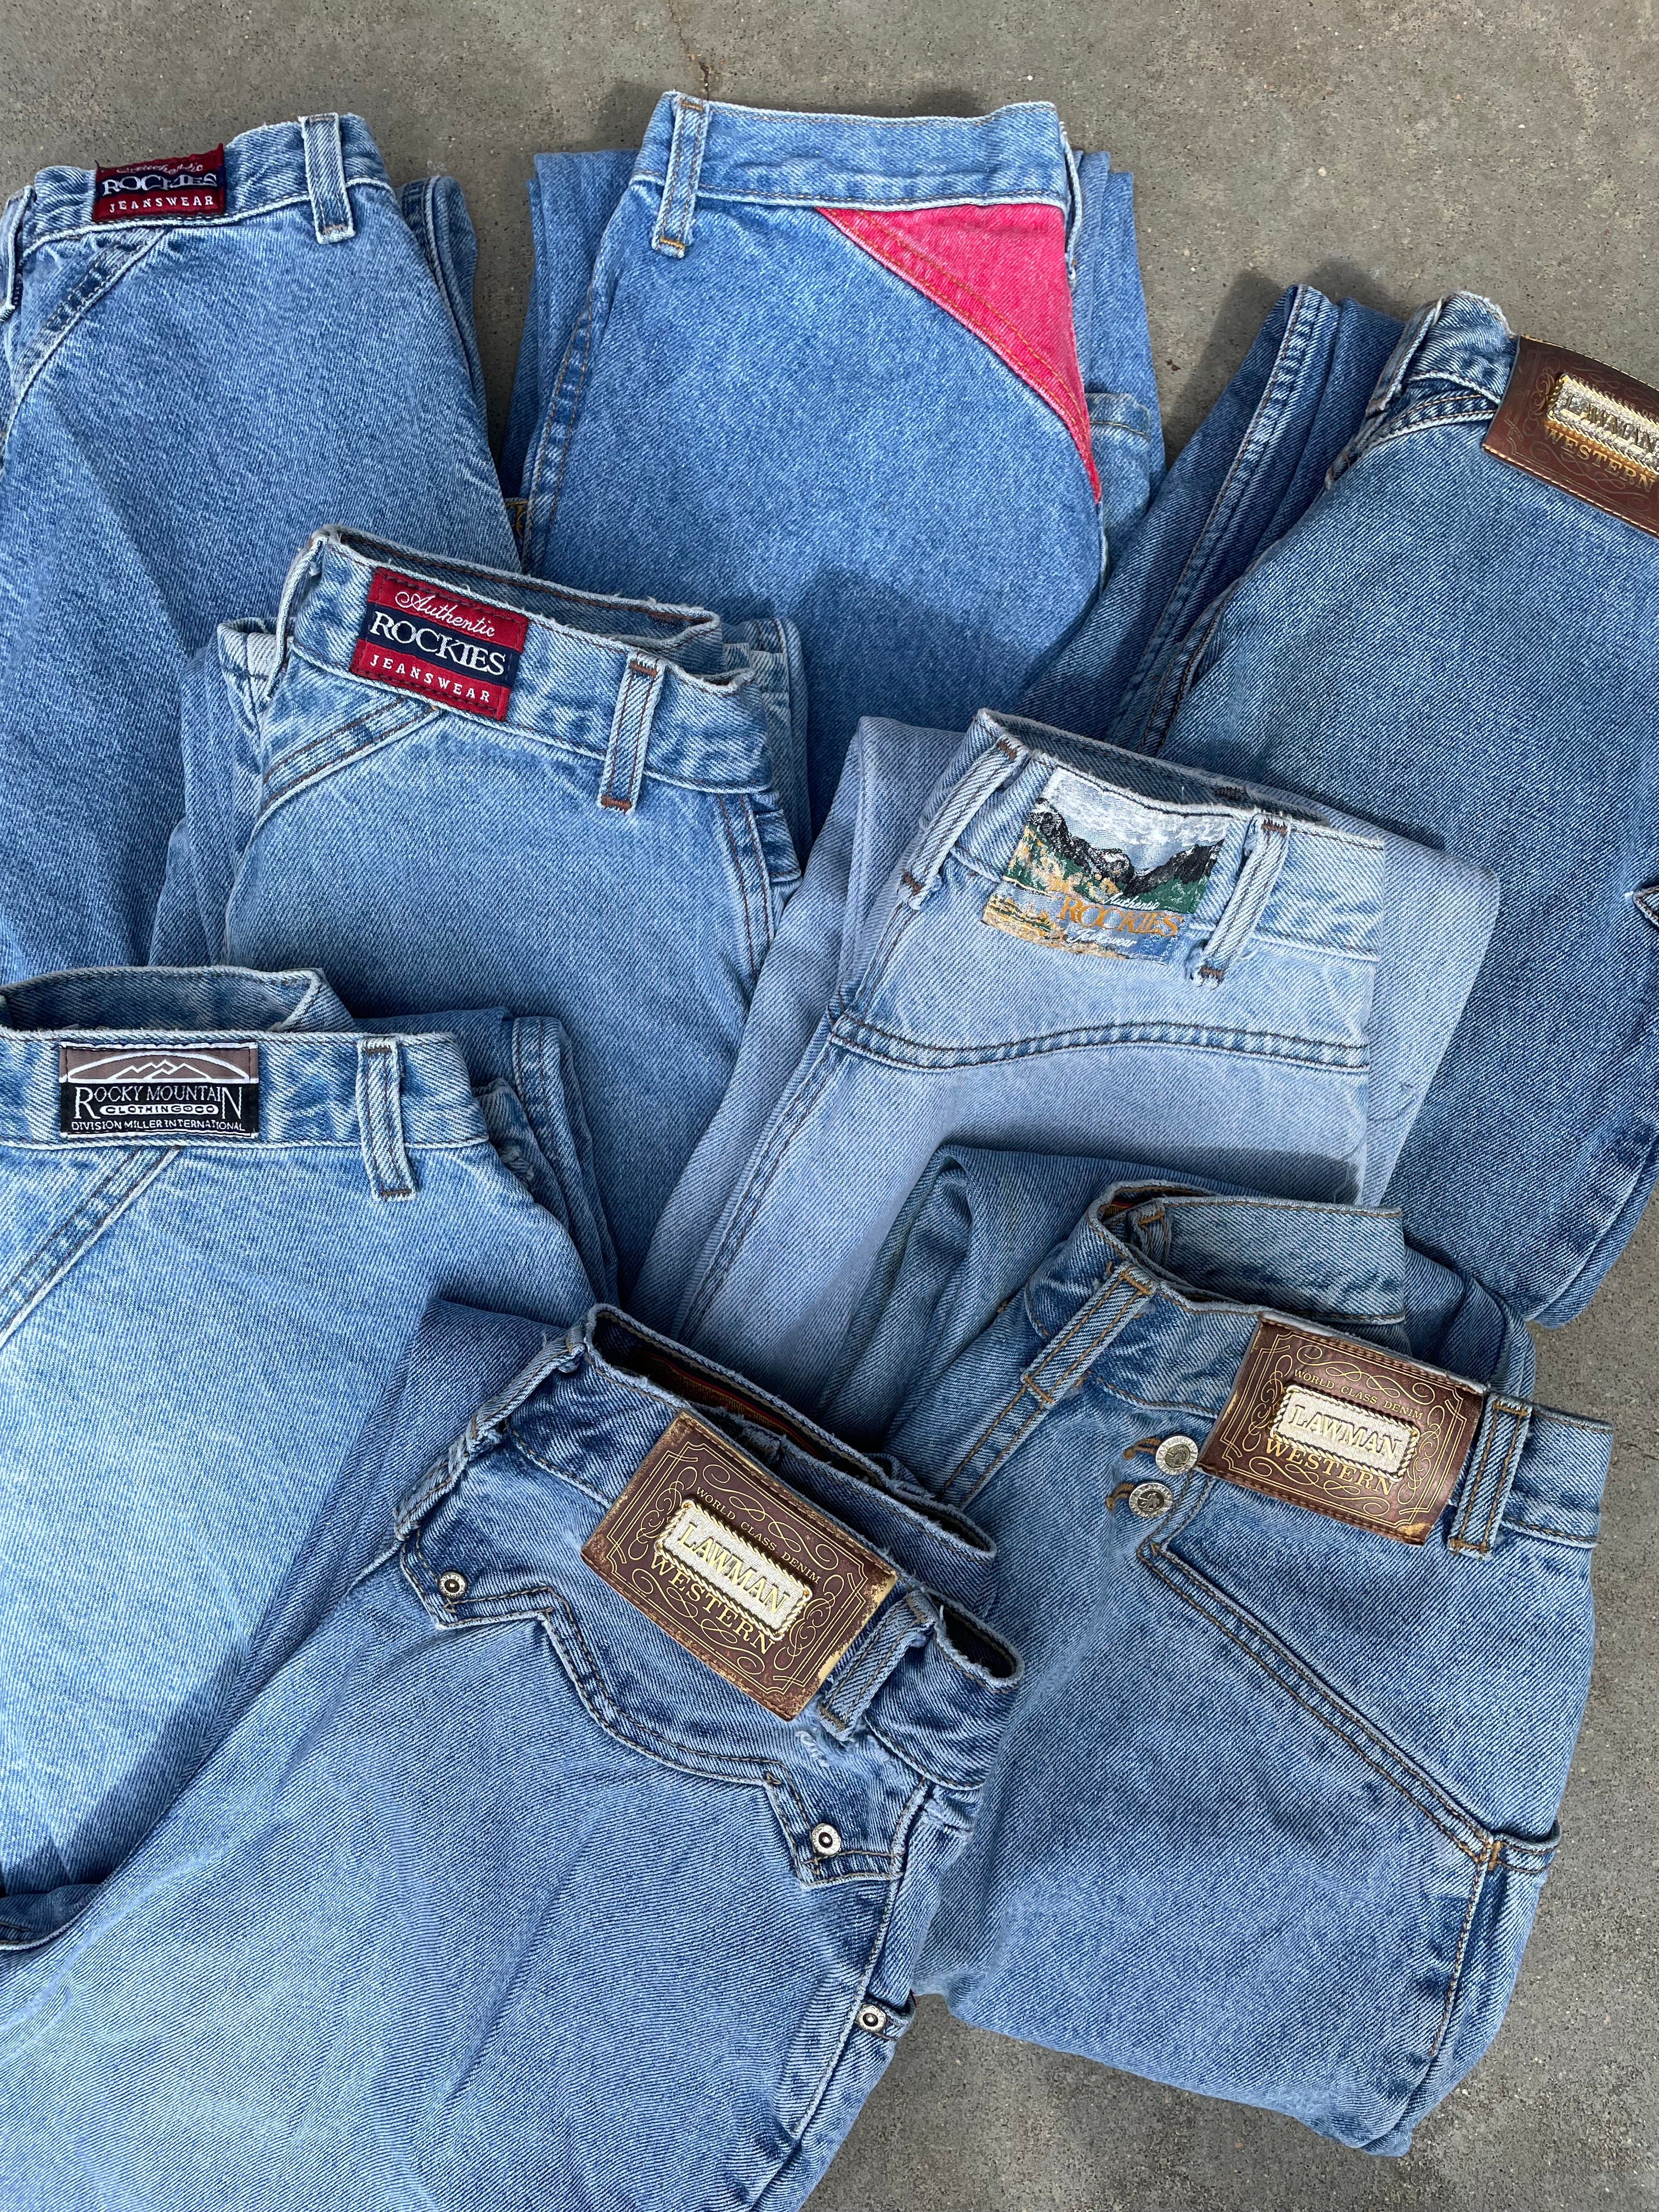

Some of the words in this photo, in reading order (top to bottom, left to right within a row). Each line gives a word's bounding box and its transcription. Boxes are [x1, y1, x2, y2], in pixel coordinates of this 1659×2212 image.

[102, 173, 217, 196] ROCKIES
[110, 195, 213, 213] JEANSWEAR
[1544, 425, 1656, 493] WESTERN
[395, 591, 495, 637] Authentic
[370, 611, 506, 675] ROCKIES
[370, 654, 490, 702] JEANSWEAR
[1056, 896, 1183, 937] ROCKIES
[1102, 892, 1161, 911] Authentic
[71, 1121, 122, 1131] DIVISION
[125, 1119, 162, 1128] MILLER
[165, 1119, 246, 1131] INTERNATIONAL
[74, 1086, 144, 1120] ROCKY
[146, 1086, 243, 1120] MOUNTAIN
[1294, 1369, 1335, 1390] WORLD
[1341, 1386, 1378, 1404] CLASS
[1383, 1400, 1423, 1420] DENIM
[1289, 1404, 1401, 1460] LAWMAN
[1266, 1438, 1395, 1496] WESTERN
[696, 1486, 736, 1520] WORLD
[741, 1521, 777, 1551] CLASS
[781, 1551, 821, 1584] DENIM
[677, 1521, 790, 1614] LAWMAN
[651, 1552, 775, 1655] WESTERN
